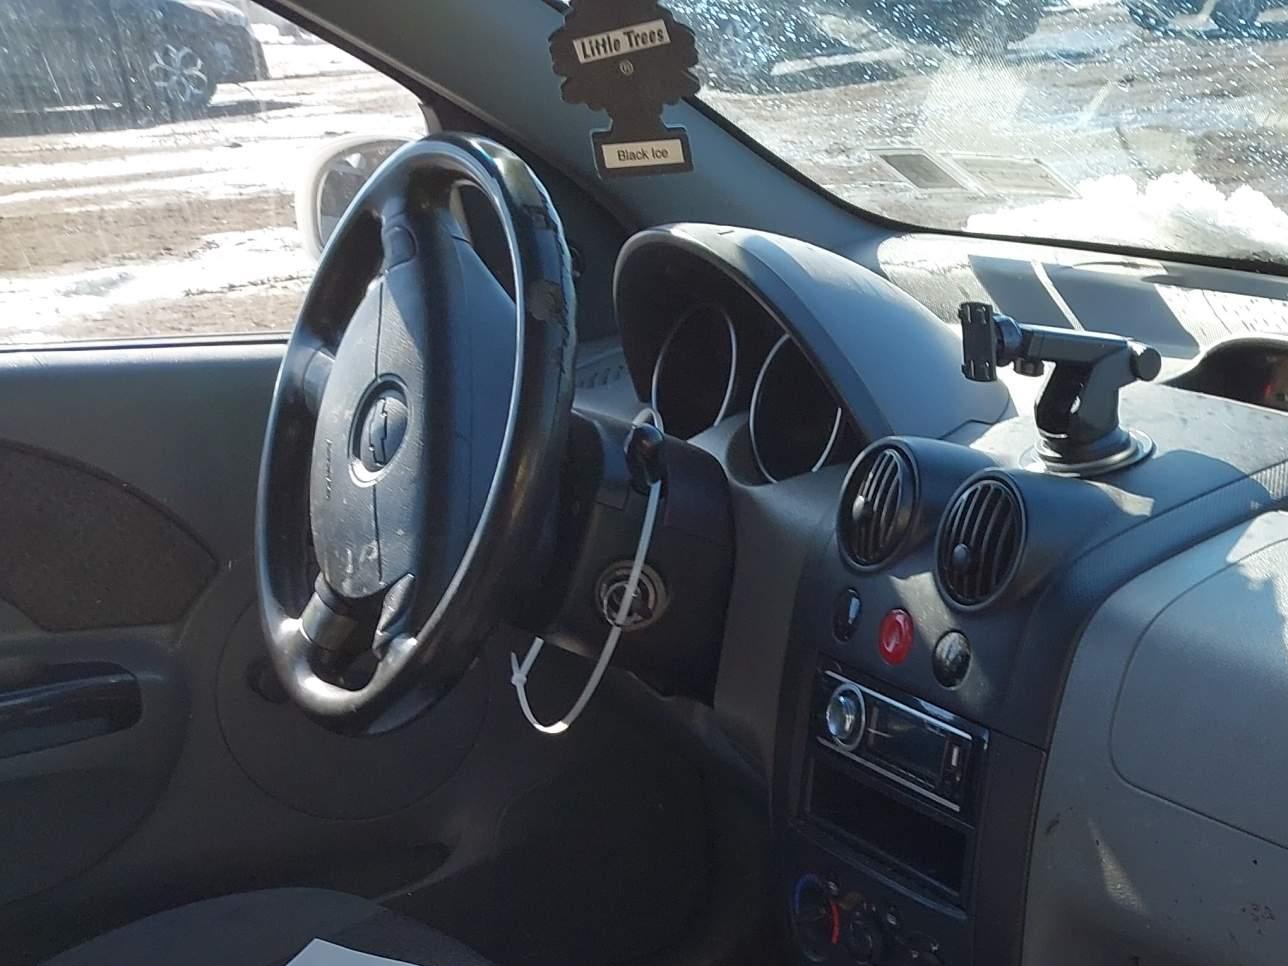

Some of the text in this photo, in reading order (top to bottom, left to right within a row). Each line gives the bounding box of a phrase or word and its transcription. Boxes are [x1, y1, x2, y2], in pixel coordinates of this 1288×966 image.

[581, 27, 665, 59] Little Trees
[617, 147, 669, 162] Black Ice
